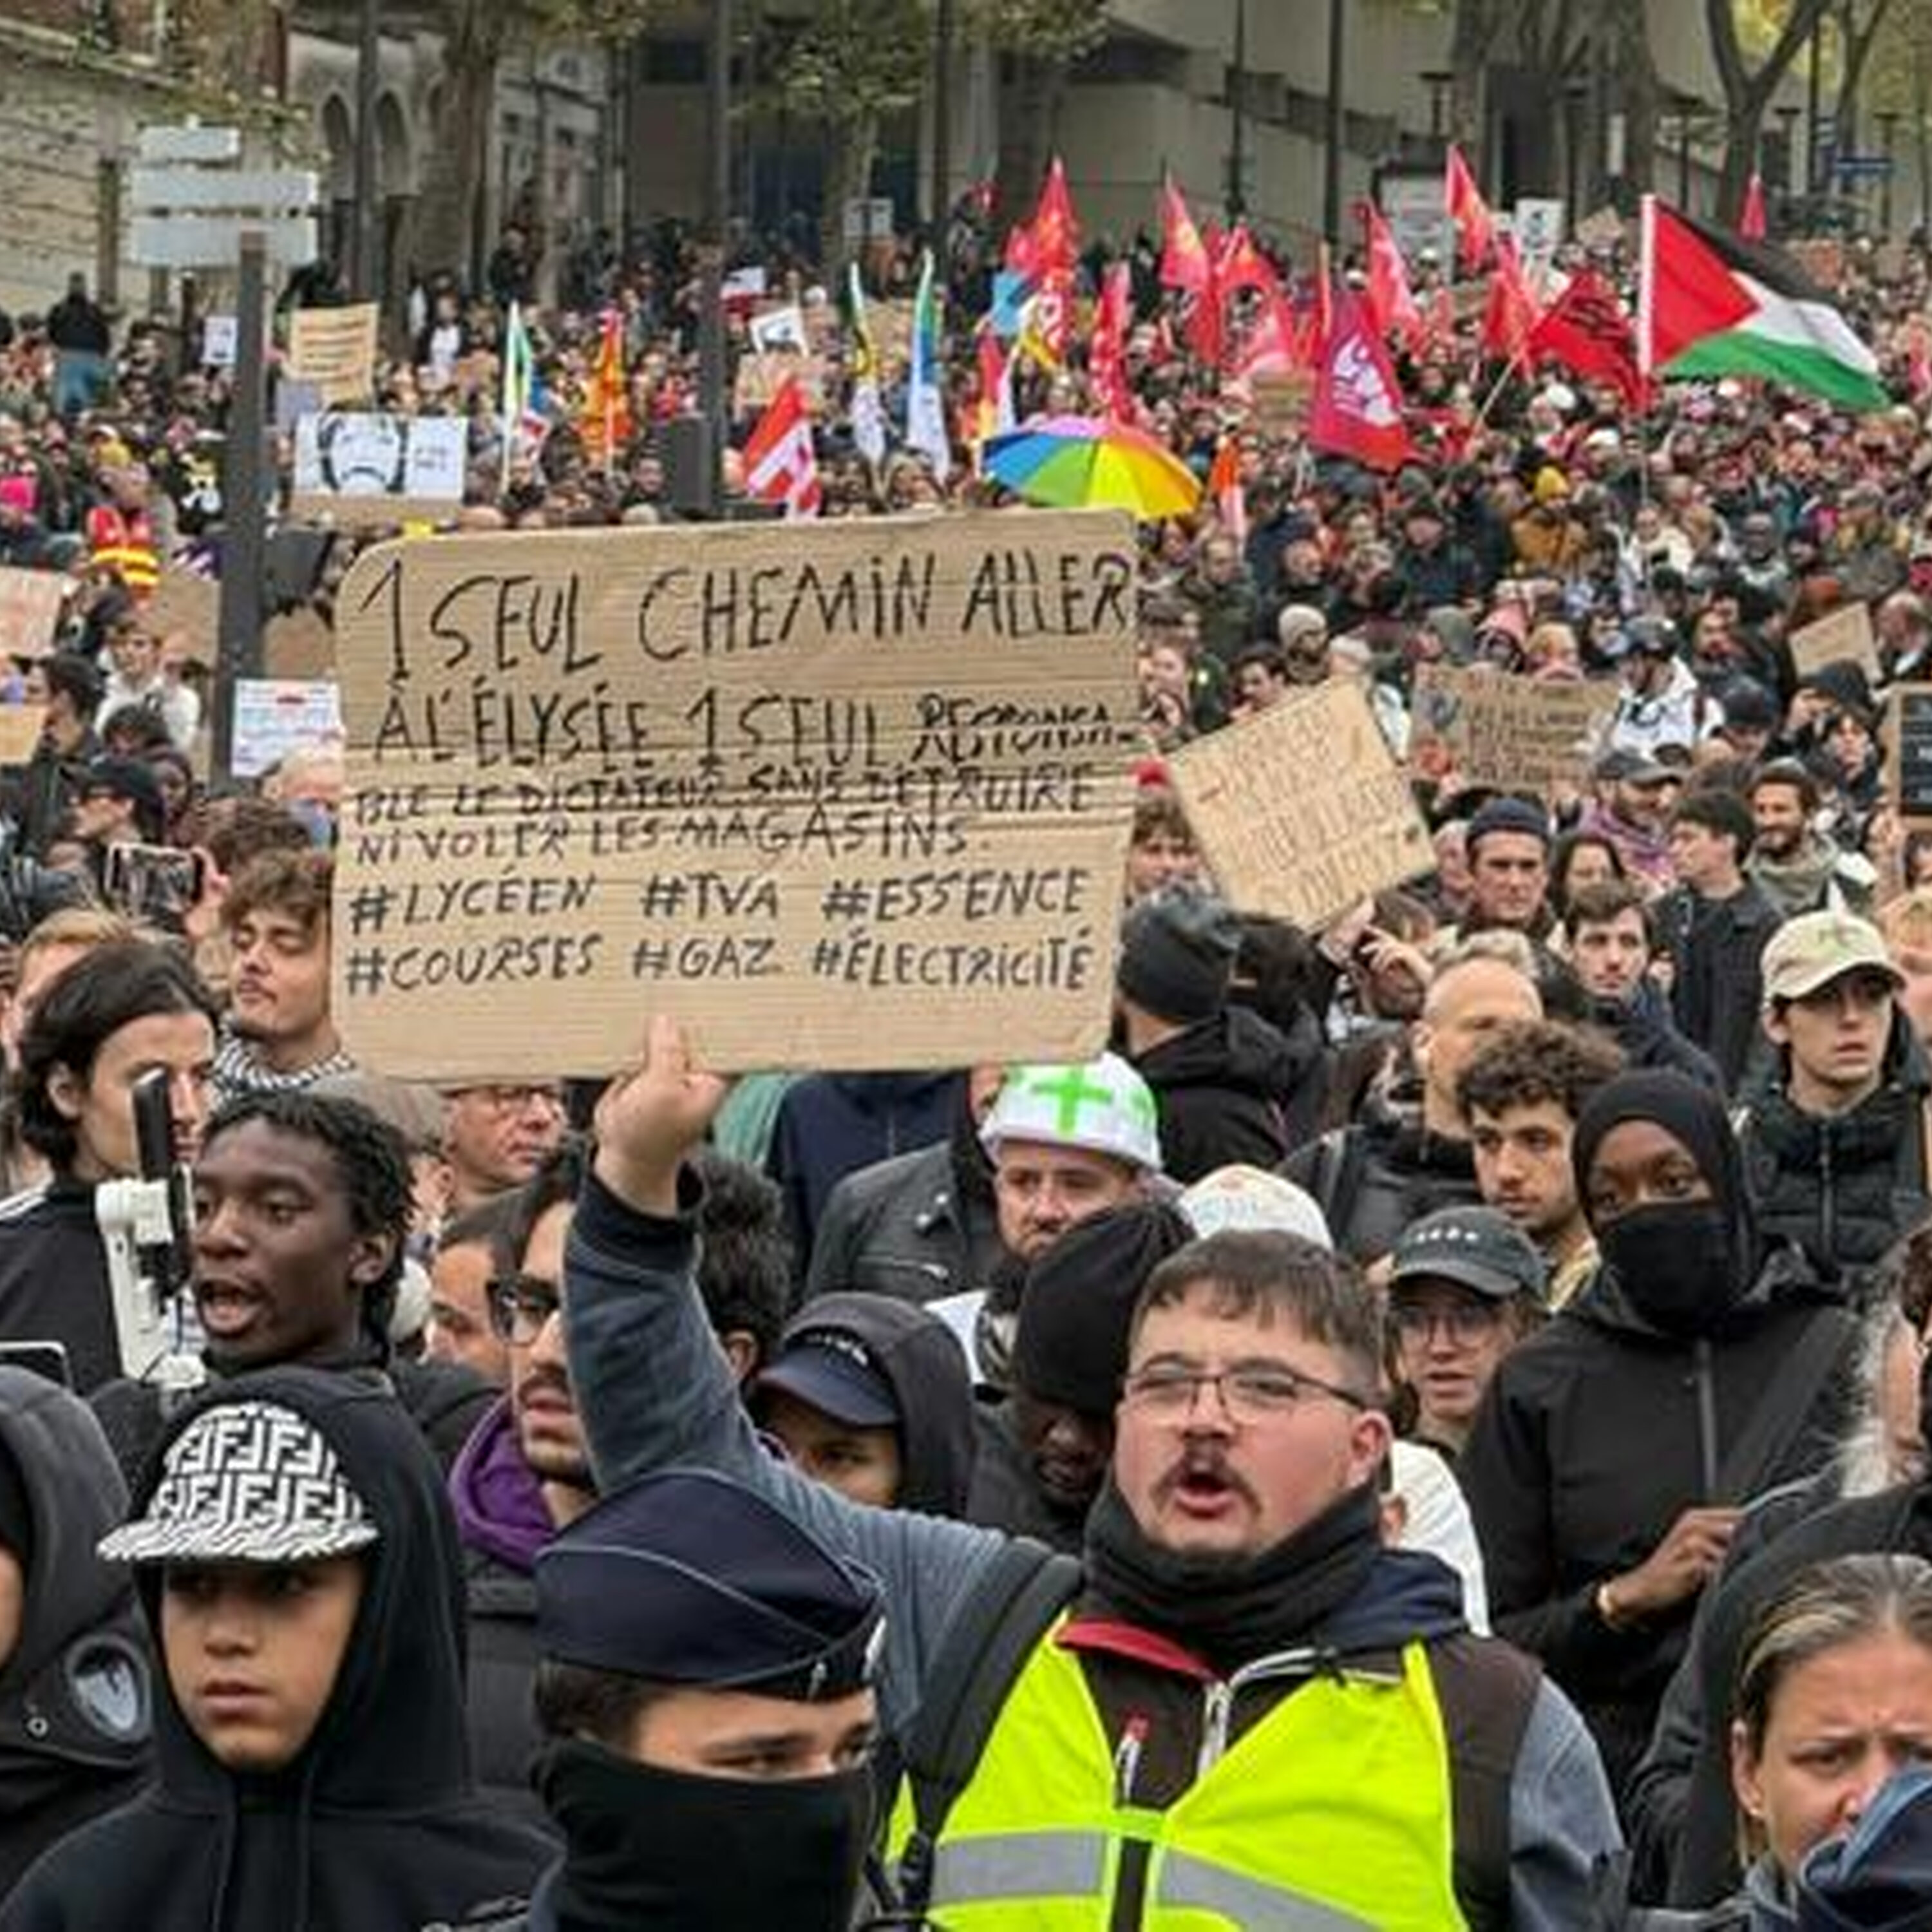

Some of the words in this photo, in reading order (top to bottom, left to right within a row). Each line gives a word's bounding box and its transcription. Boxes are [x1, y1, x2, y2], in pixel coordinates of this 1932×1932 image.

[430, 573, 603, 675] SEUL
[960, 549, 1132, 639] ALLER
[685, 687, 728, 768] 1
[738, 693, 889, 768] SEUL
[355, 784, 426, 826] BLE
[452, 783, 501, 816] LE
[747, 764, 844, 803] SANS
[414, 815, 569, 862] VOLER
[591, 815, 662, 858] LES
[640, 872, 779, 921] #TVA
[822, 868, 1094, 921] #ESSENCE
[346, 933, 604, 997] #COURSES
[632, 938, 775, 980] #GAZ
